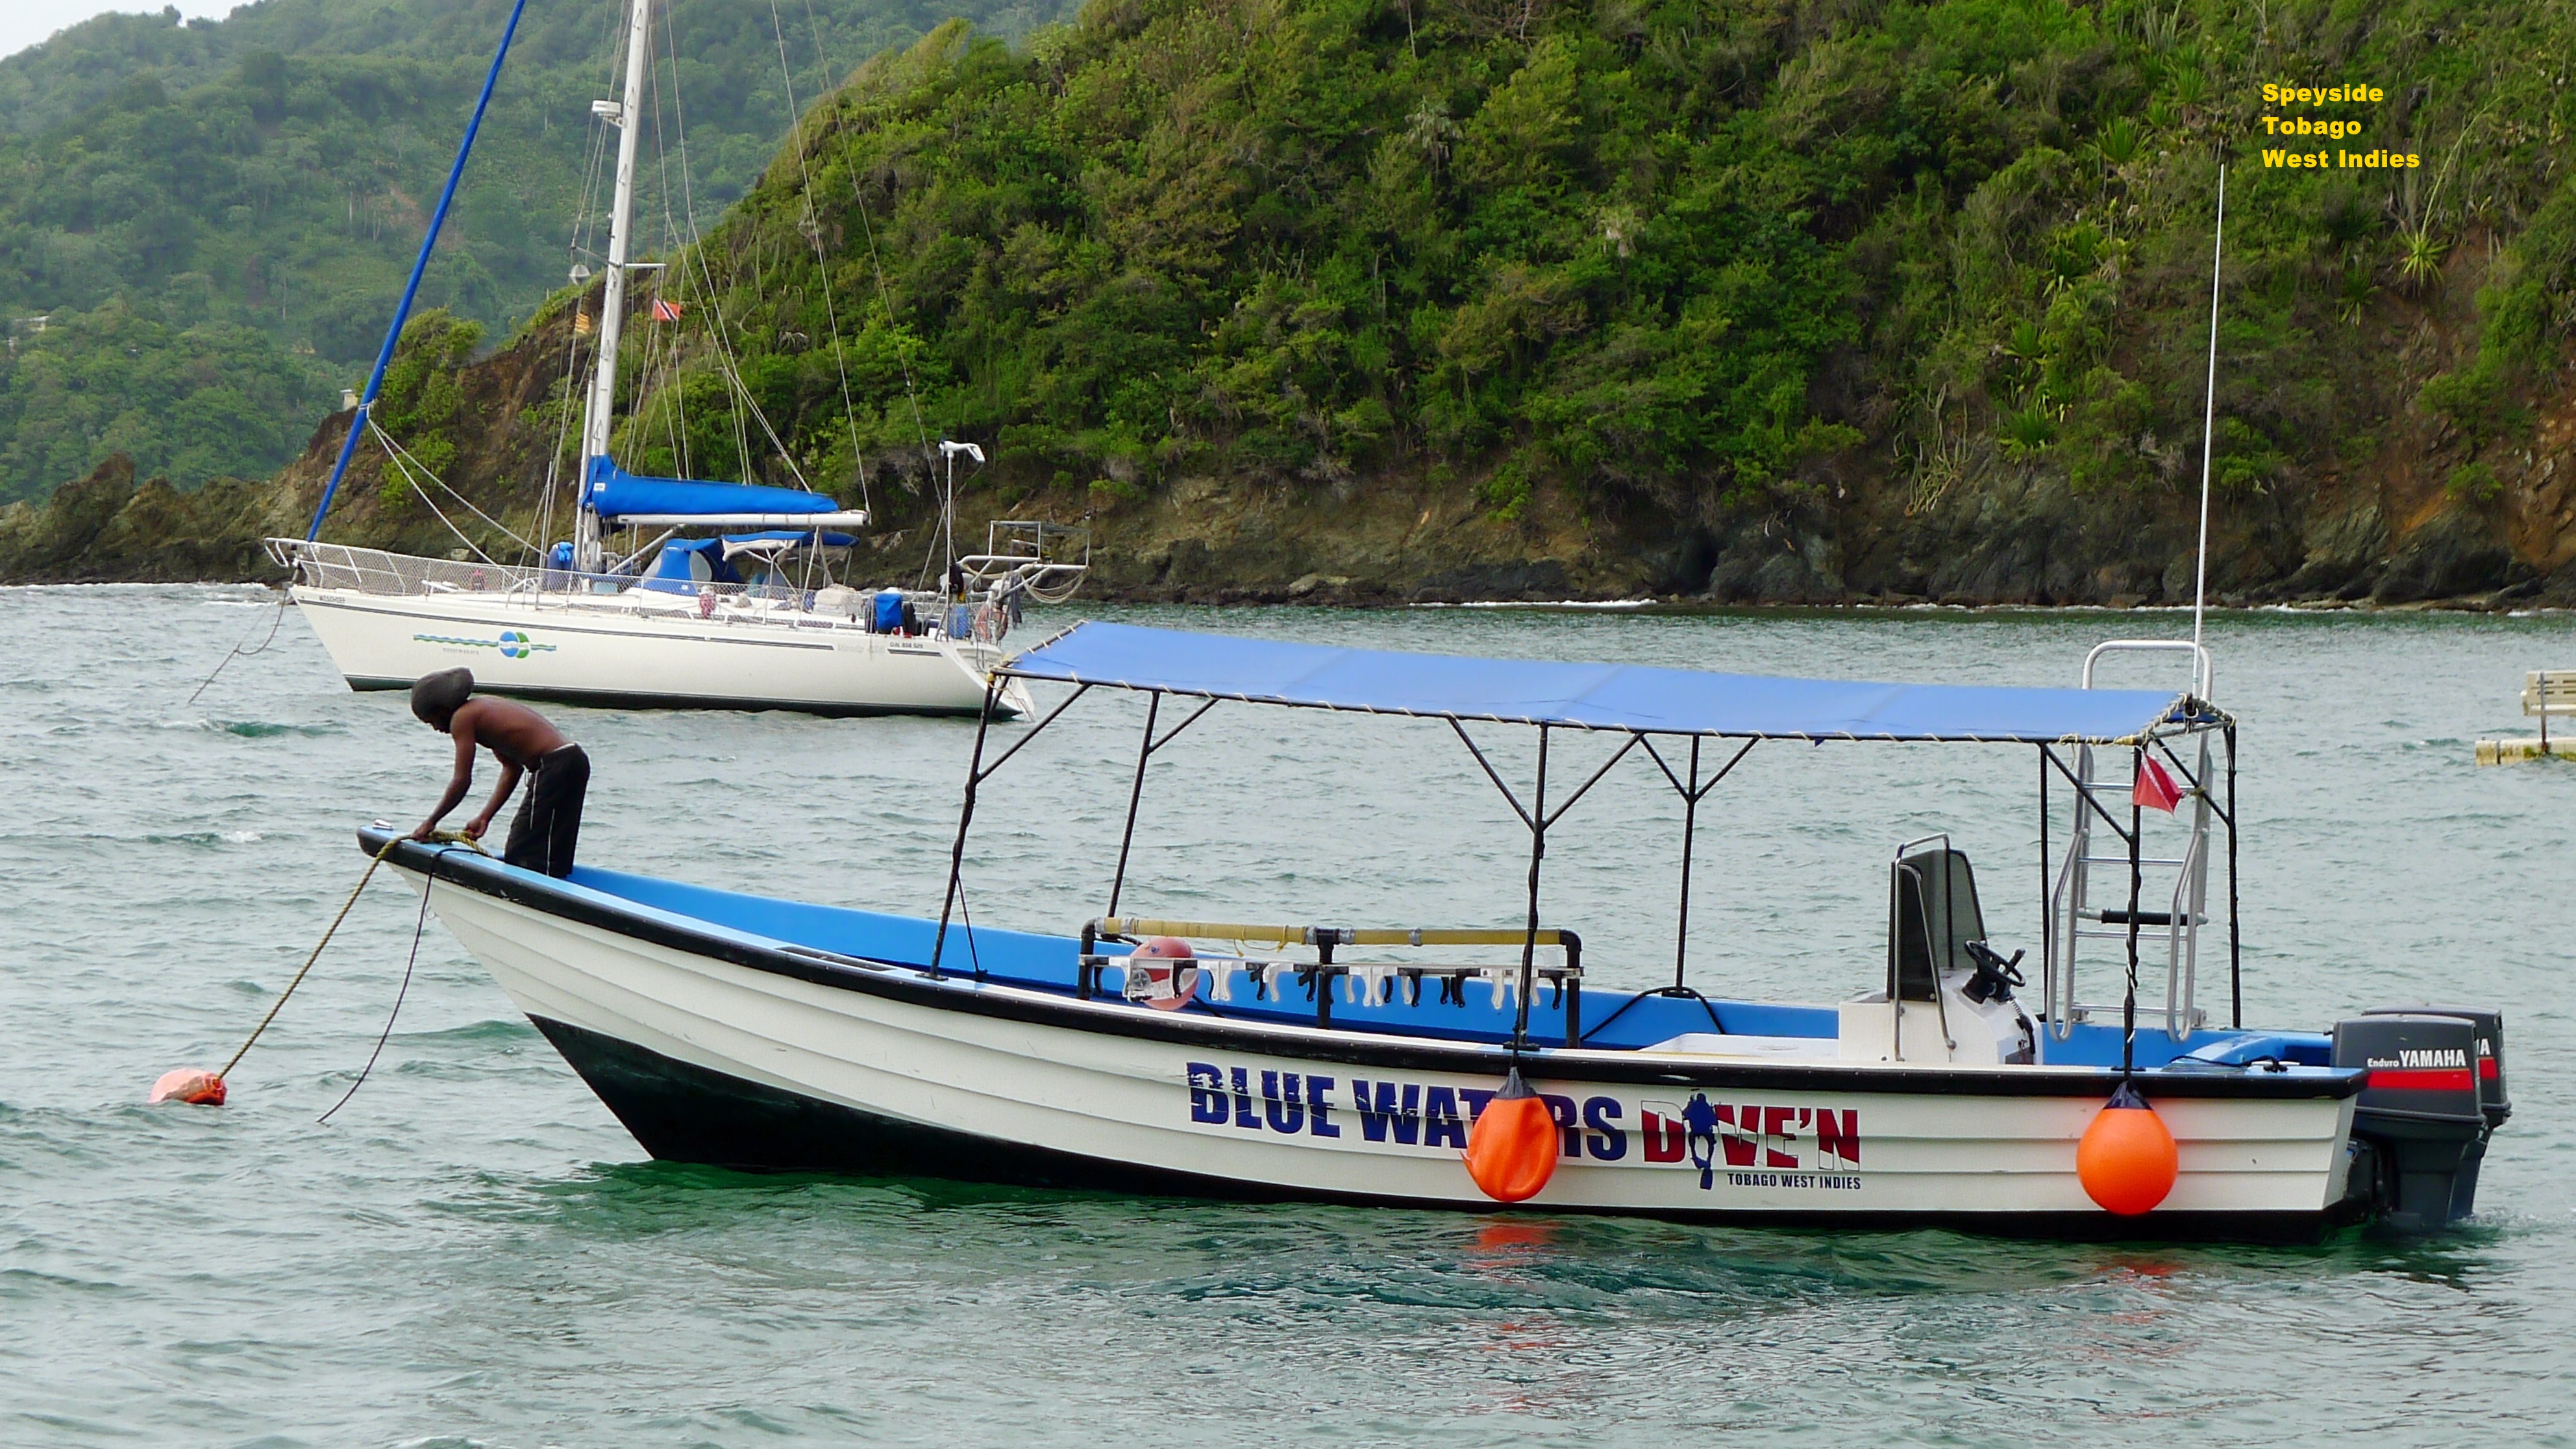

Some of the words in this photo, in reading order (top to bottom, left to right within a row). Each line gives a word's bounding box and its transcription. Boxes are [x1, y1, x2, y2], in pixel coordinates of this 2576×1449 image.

[2367, 1058, 2400, 1068] Enduro
[2399, 1048, 2466, 1067] YAMAHA
[1186, 1061, 1341, 1139] BLUE
[1352, 1079, 1628, 1161] WATRS
[1727, 1172, 1777, 1187] TOBAGO
[1781, 1174, 1816, 1188] WEST
[1819, 1176, 1861, 1190] INDIES
